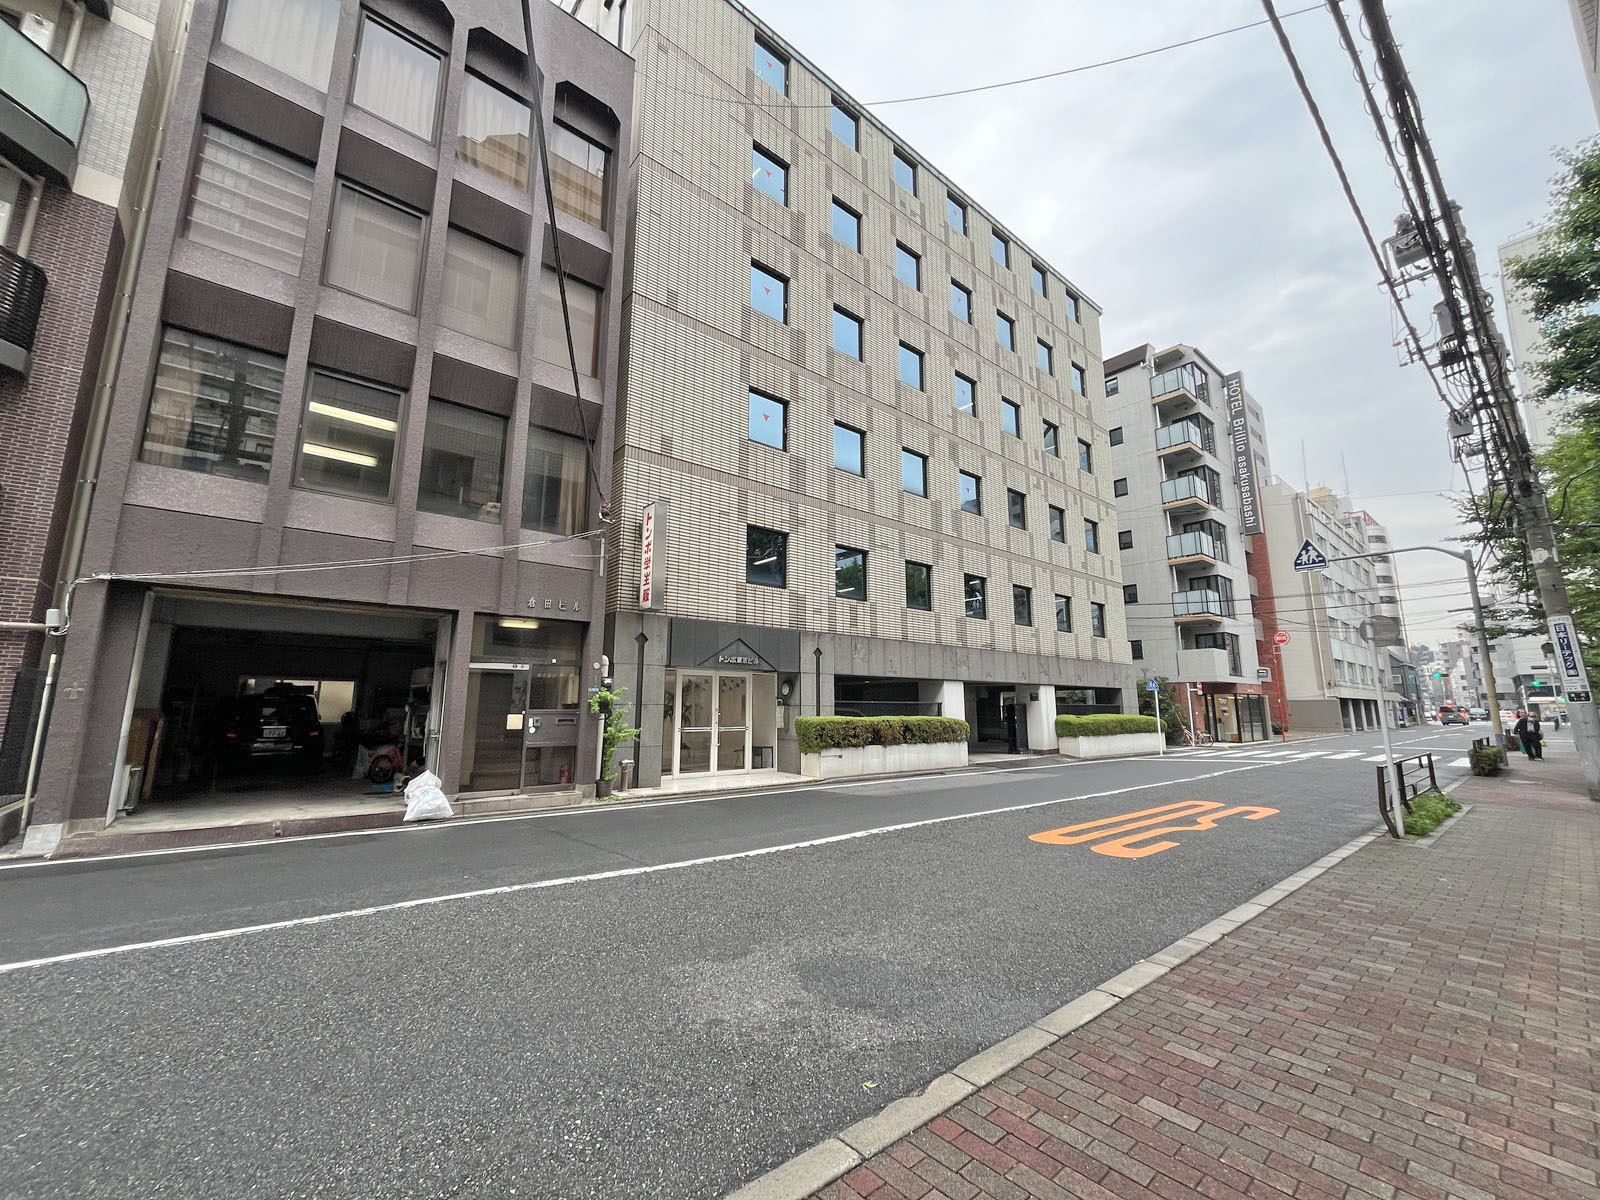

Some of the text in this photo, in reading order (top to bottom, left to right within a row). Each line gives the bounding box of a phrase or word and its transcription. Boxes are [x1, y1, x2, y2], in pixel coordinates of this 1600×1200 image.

[1228, 379, 1257, 528] HOTEL Brillio asakusabashi
